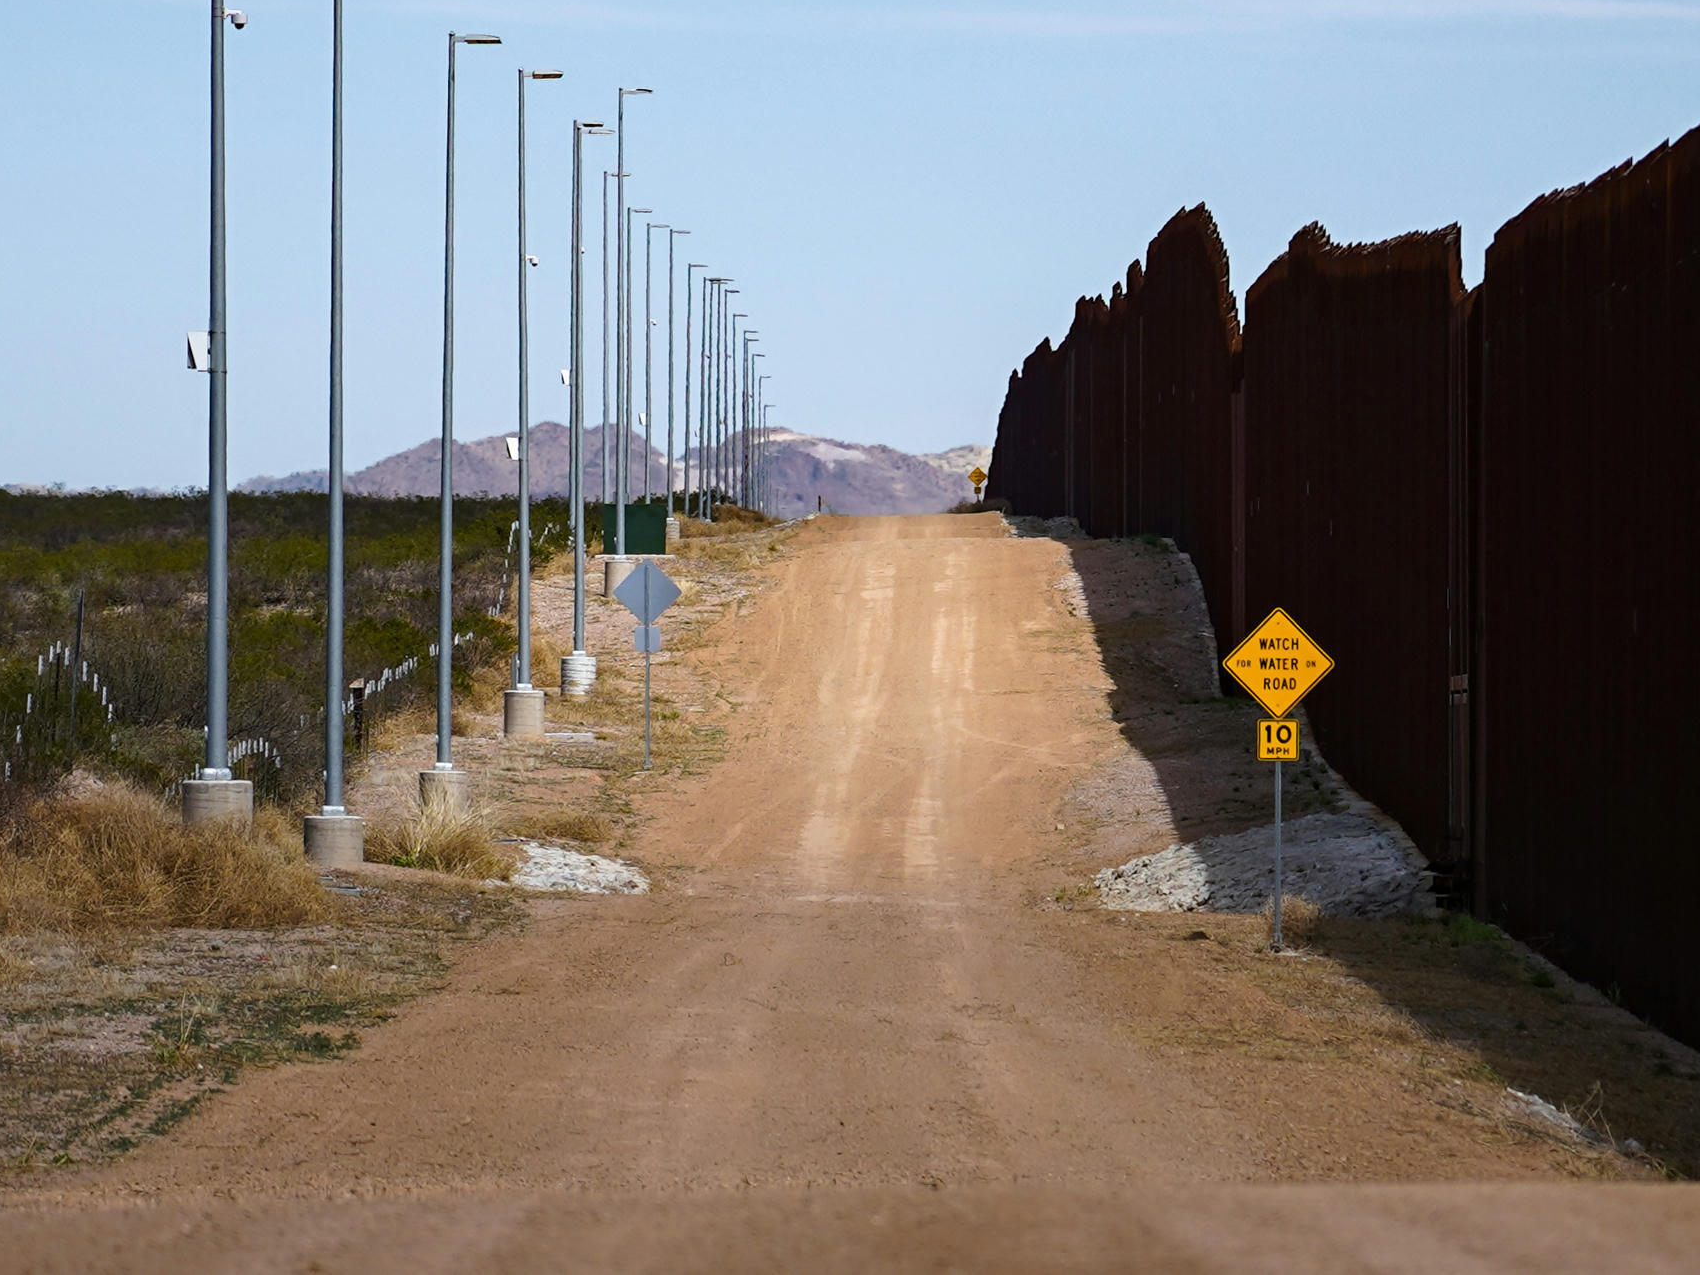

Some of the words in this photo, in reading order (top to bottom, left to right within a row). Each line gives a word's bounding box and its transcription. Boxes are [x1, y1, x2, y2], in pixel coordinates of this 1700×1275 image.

[1259, 638, 1299, 650] WATCH
[1236, 659, 1252, 668] FOR
[1259, 658, 1299, 670] WATER
[1306, 660, 1316, 668] ON
[1263, 677, 1297, 690] ROAD
[1265, 725, 1292, 743] 10
[1267, 747, 1290, 755] MPH
